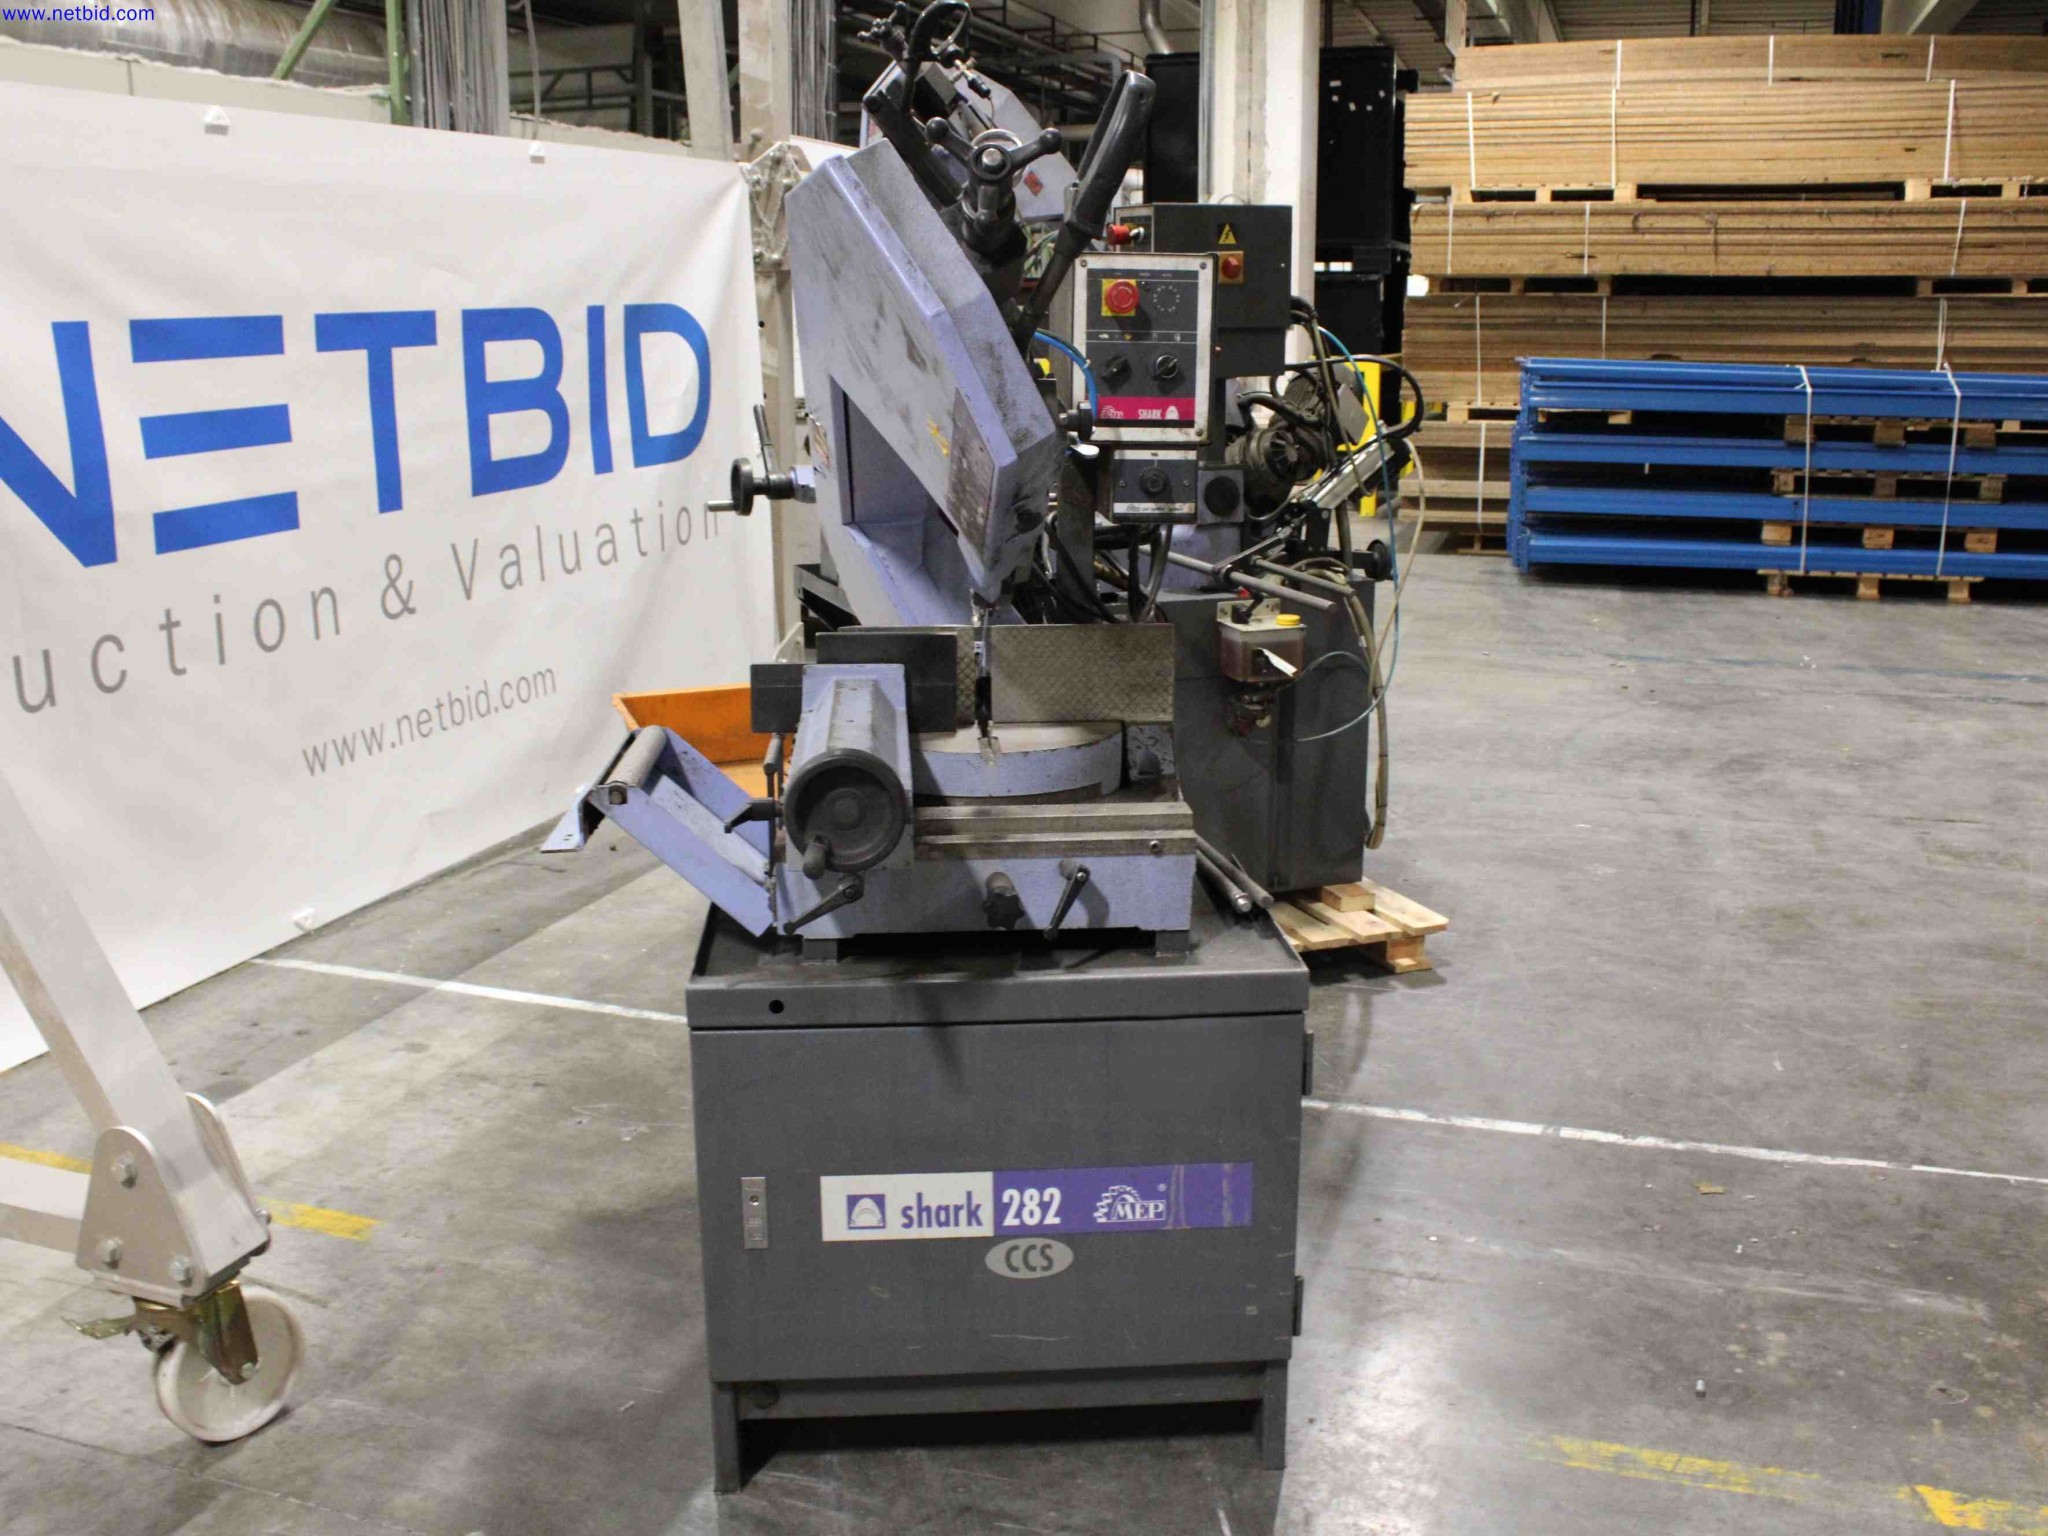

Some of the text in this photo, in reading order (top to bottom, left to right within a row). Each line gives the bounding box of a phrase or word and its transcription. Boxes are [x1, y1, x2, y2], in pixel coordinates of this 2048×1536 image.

[1138, 409, 1162, 419] SHARK
[12, 500, 718, 714] uction & Valuation
[302, 663, 557, 777] www.netbid.com
[901, 1188, 1164, 1229] shark 282 MEP
[1005, 1244, 1054, 1272] CCS
